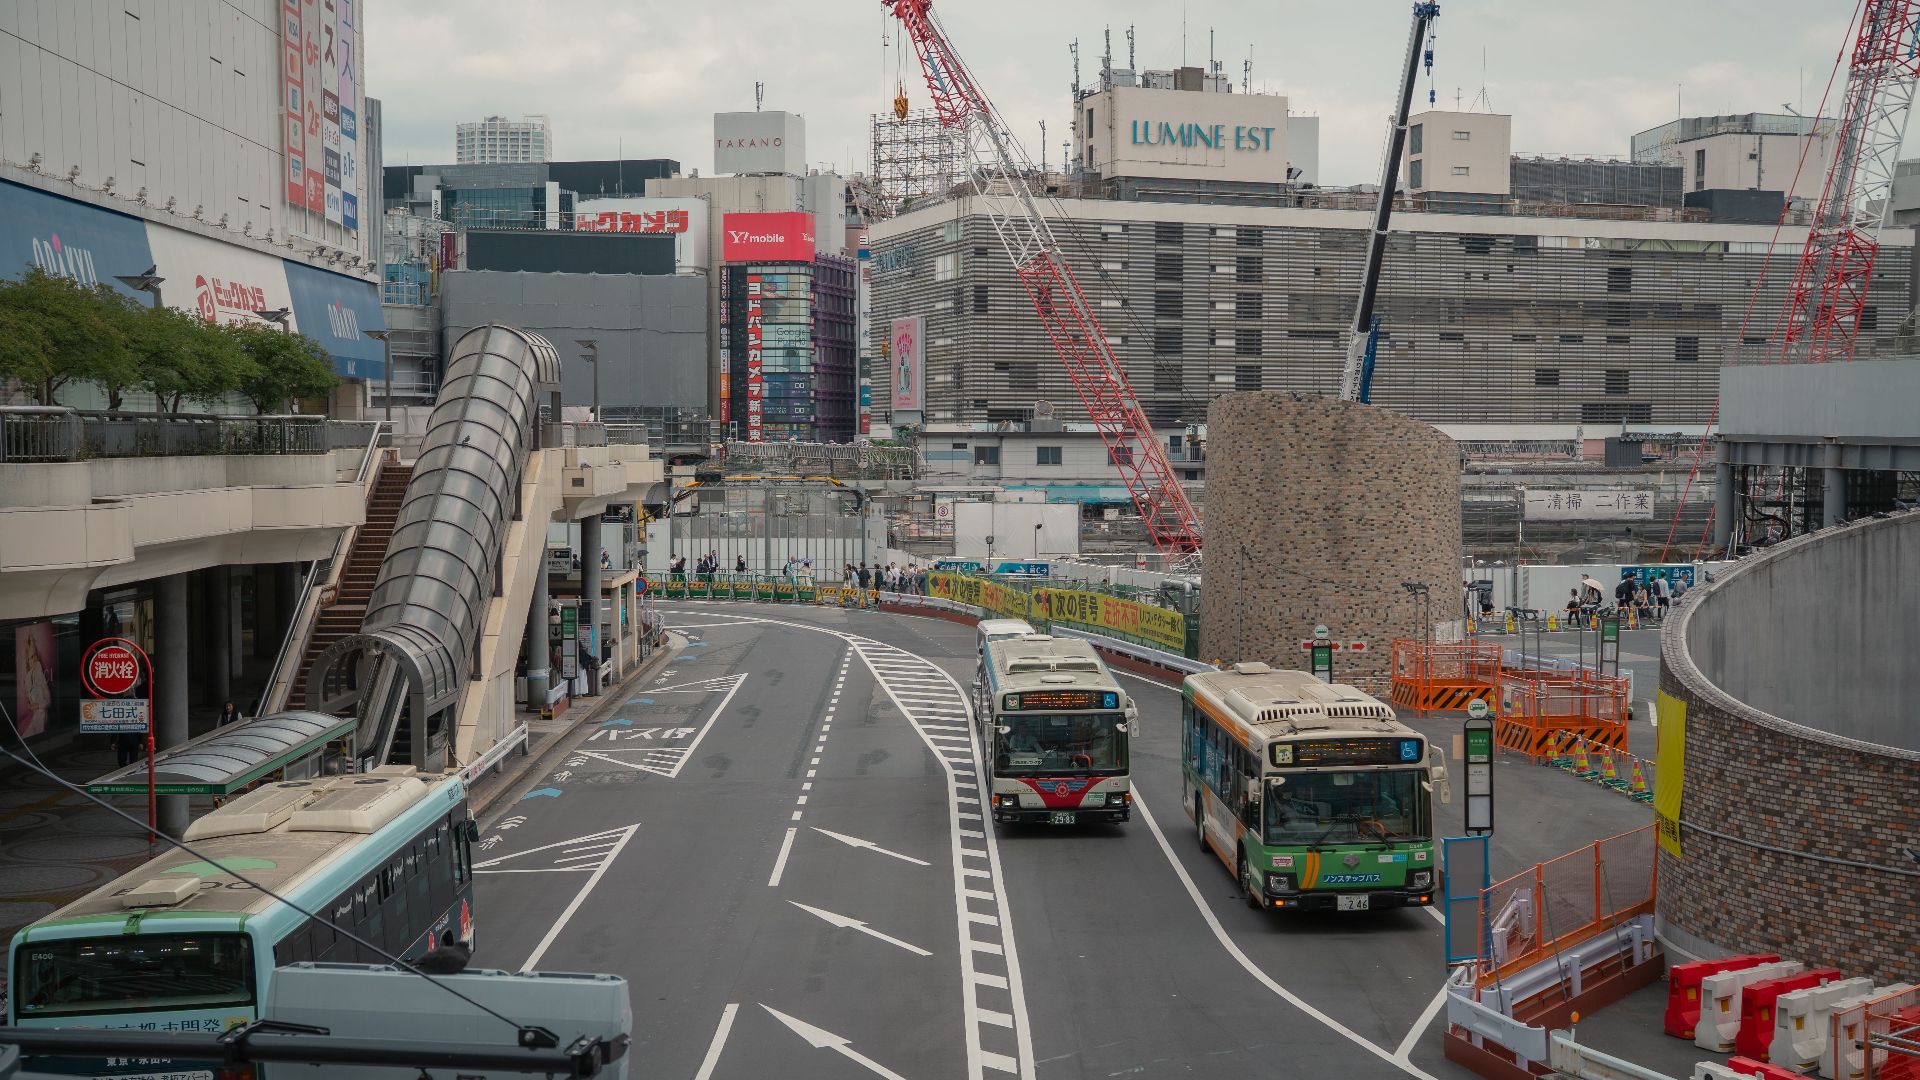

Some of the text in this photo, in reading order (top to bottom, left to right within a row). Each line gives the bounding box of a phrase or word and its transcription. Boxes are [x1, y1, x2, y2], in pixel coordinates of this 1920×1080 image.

[1132, 120, 1276, 151] LUMINE EST
[717, 137, 783, 149] TAKANO
[776, 327, 806, 337] Google
[1055, 593, 1099, 622] 次の信号
[1103, 600, 1139, 632] 左折不可
[94, 661, 134, 679] 消火栓
[99, 706, 138, 719] 七田式
[1323, 874, 1381, 883] ノンステップバス
[31, 953, 54, 961] E400
